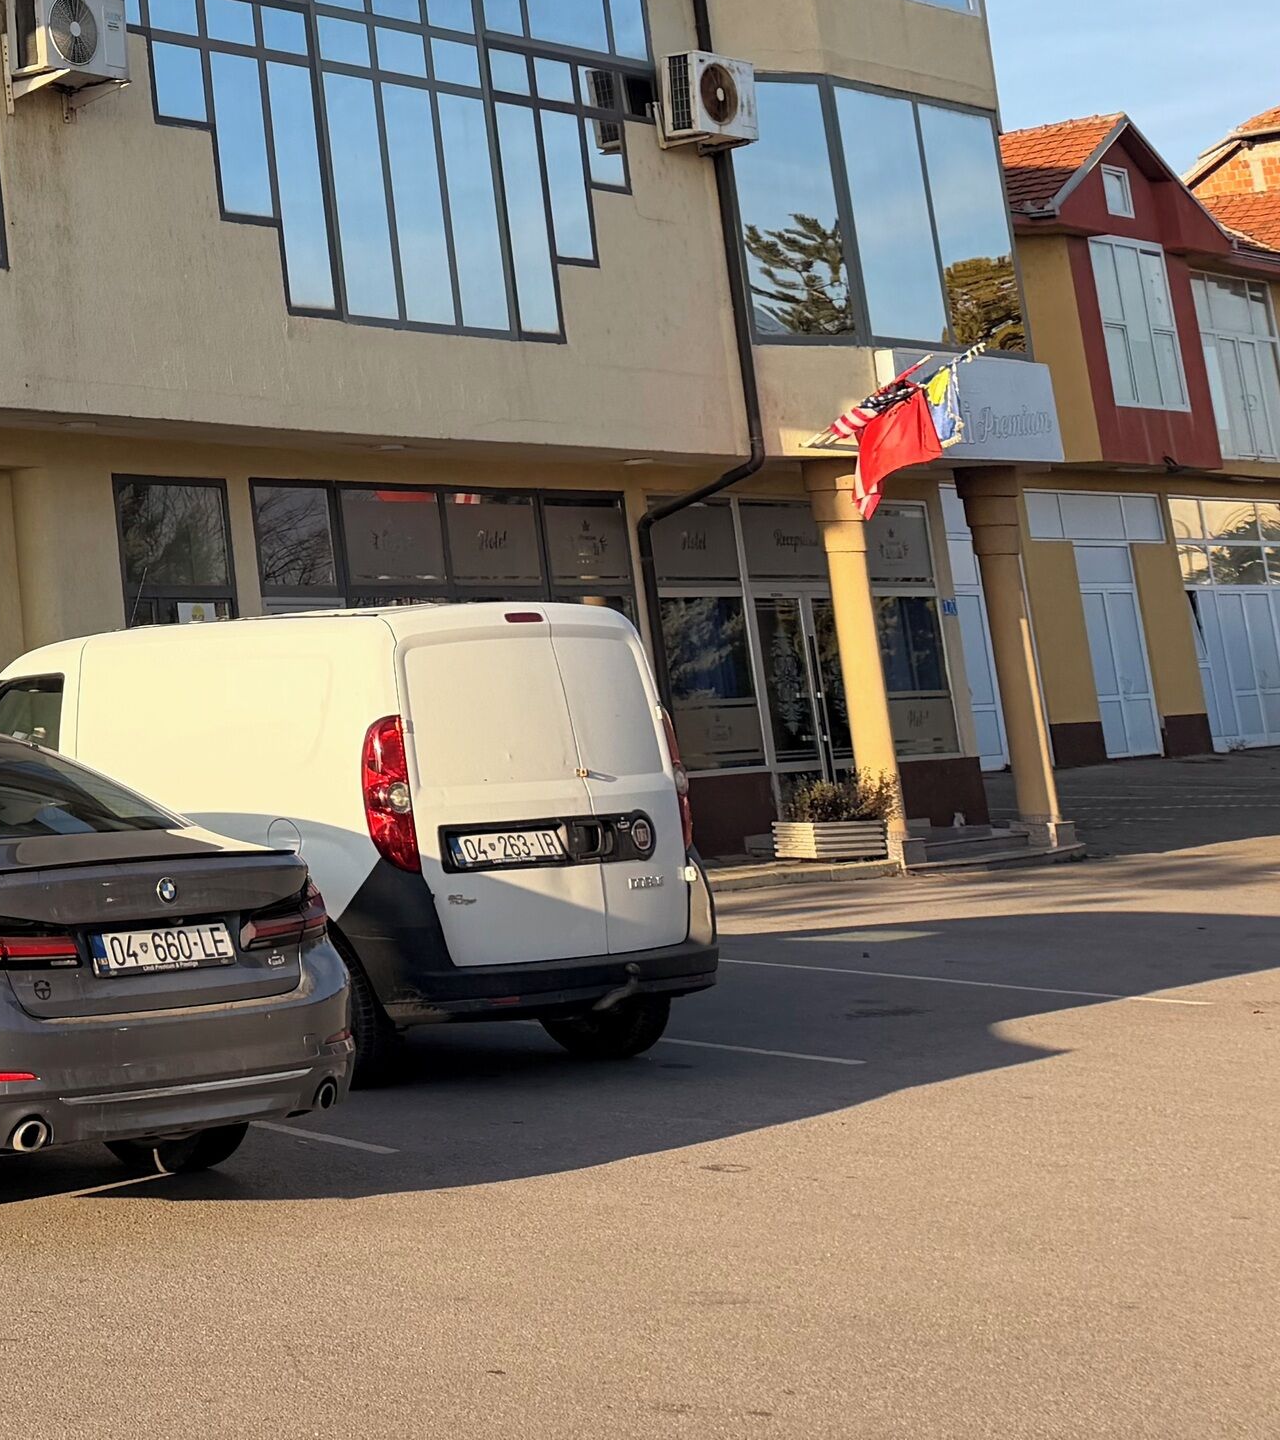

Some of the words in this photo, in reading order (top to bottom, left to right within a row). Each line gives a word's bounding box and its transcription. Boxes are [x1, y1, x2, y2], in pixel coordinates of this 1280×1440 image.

[977, 406, 1052, 444] Premium
[464, 835, 488, 861] 04
[110, 935, 138, 966] 04
